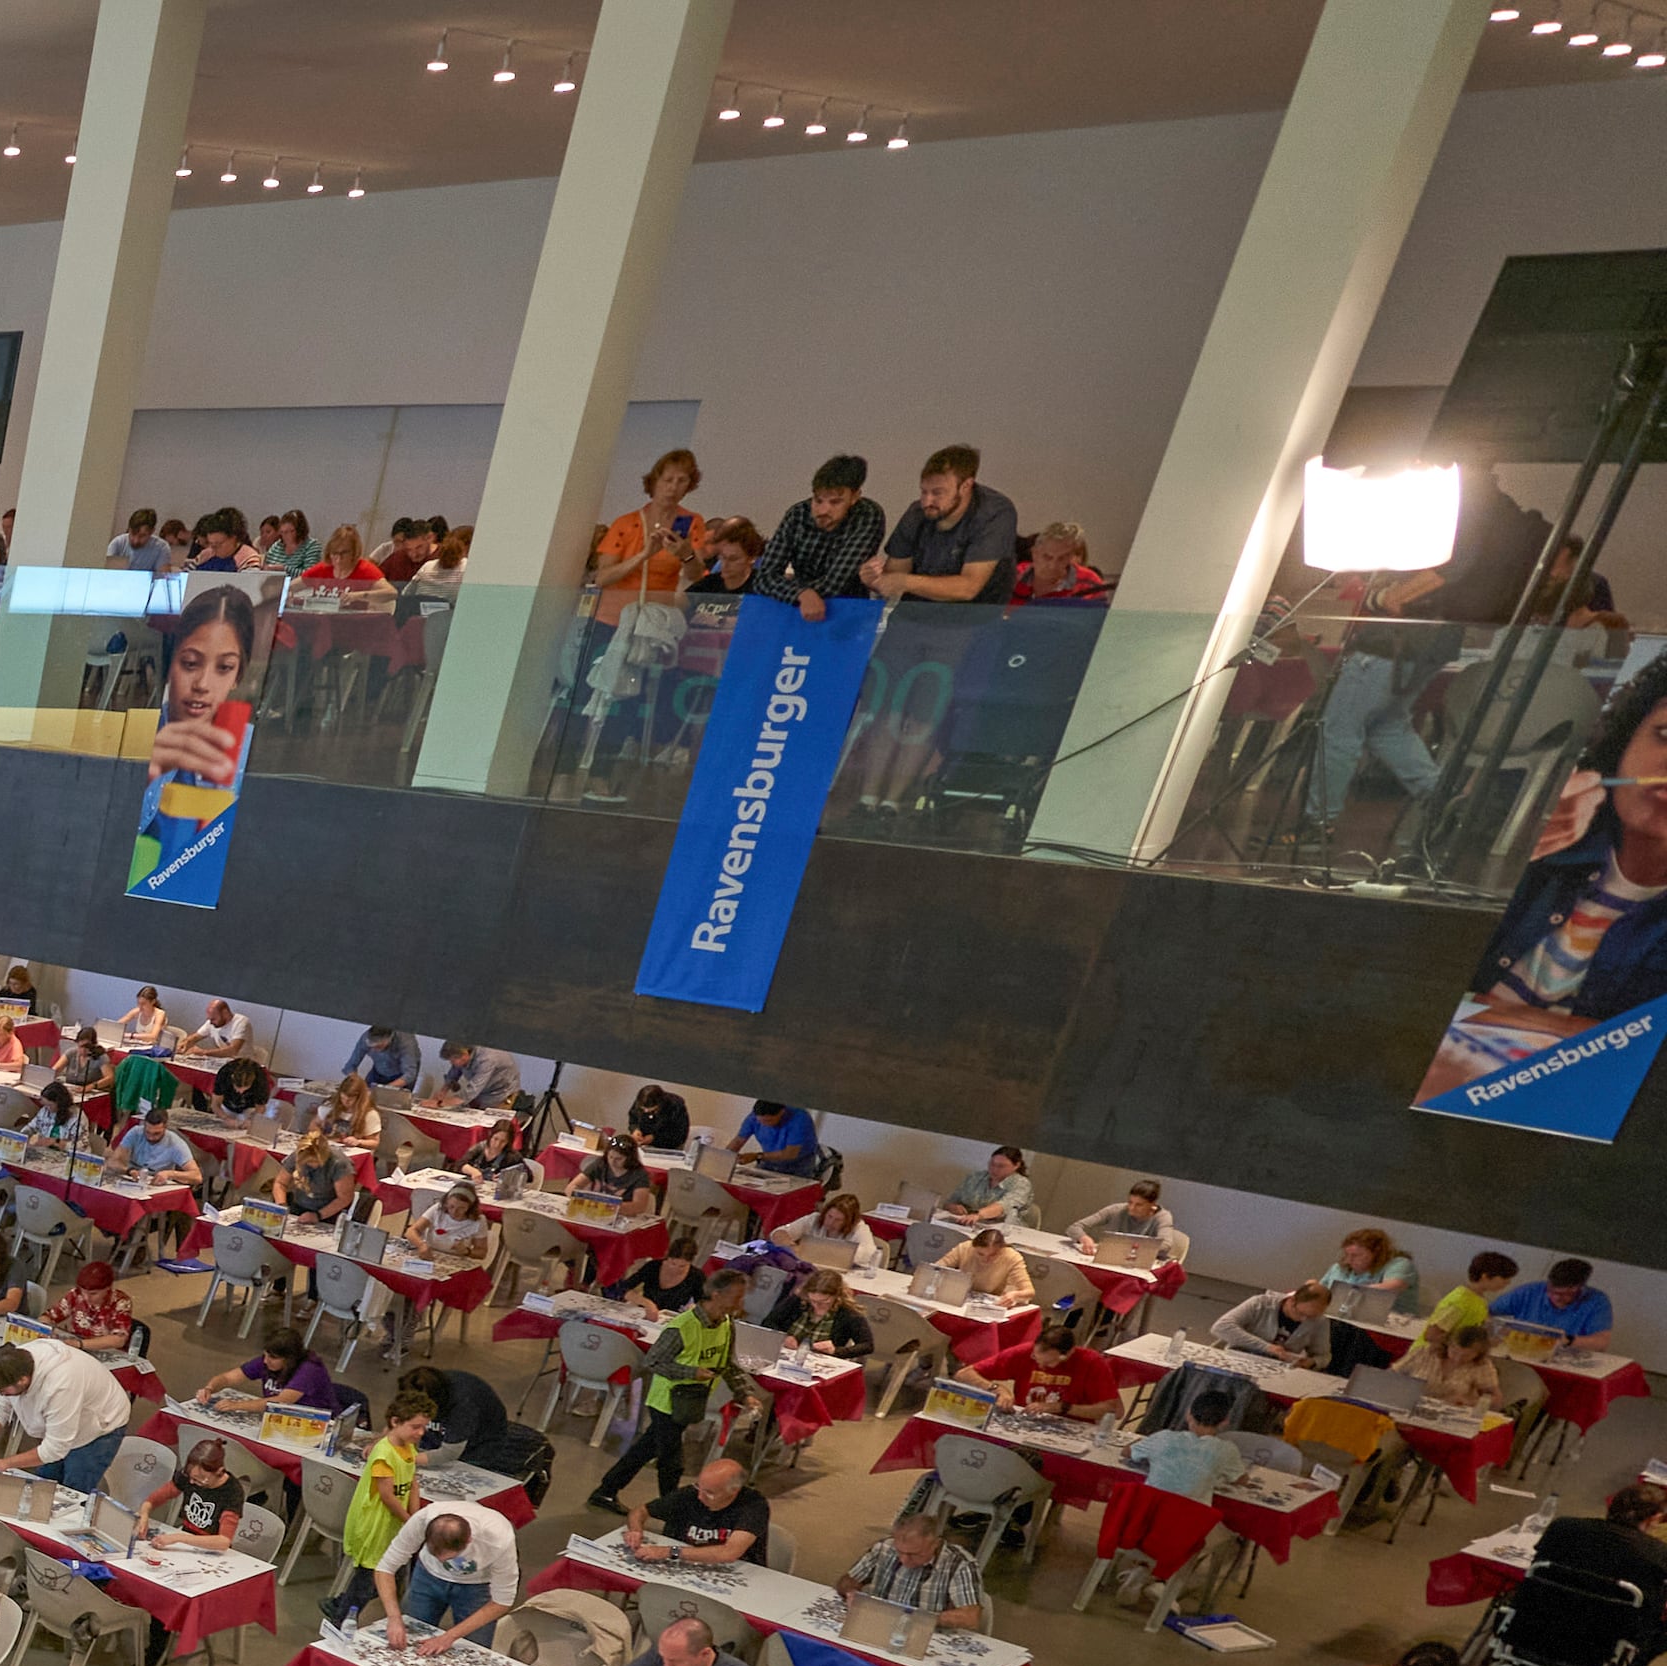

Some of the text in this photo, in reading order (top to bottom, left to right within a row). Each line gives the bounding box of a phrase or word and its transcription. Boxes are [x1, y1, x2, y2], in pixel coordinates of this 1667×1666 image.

[690, 646, 810, 953] Ravensburger
[147, 822, 225, 890] Ravensburger
[1466, 1015, 1652, 1106] Ravensburger
